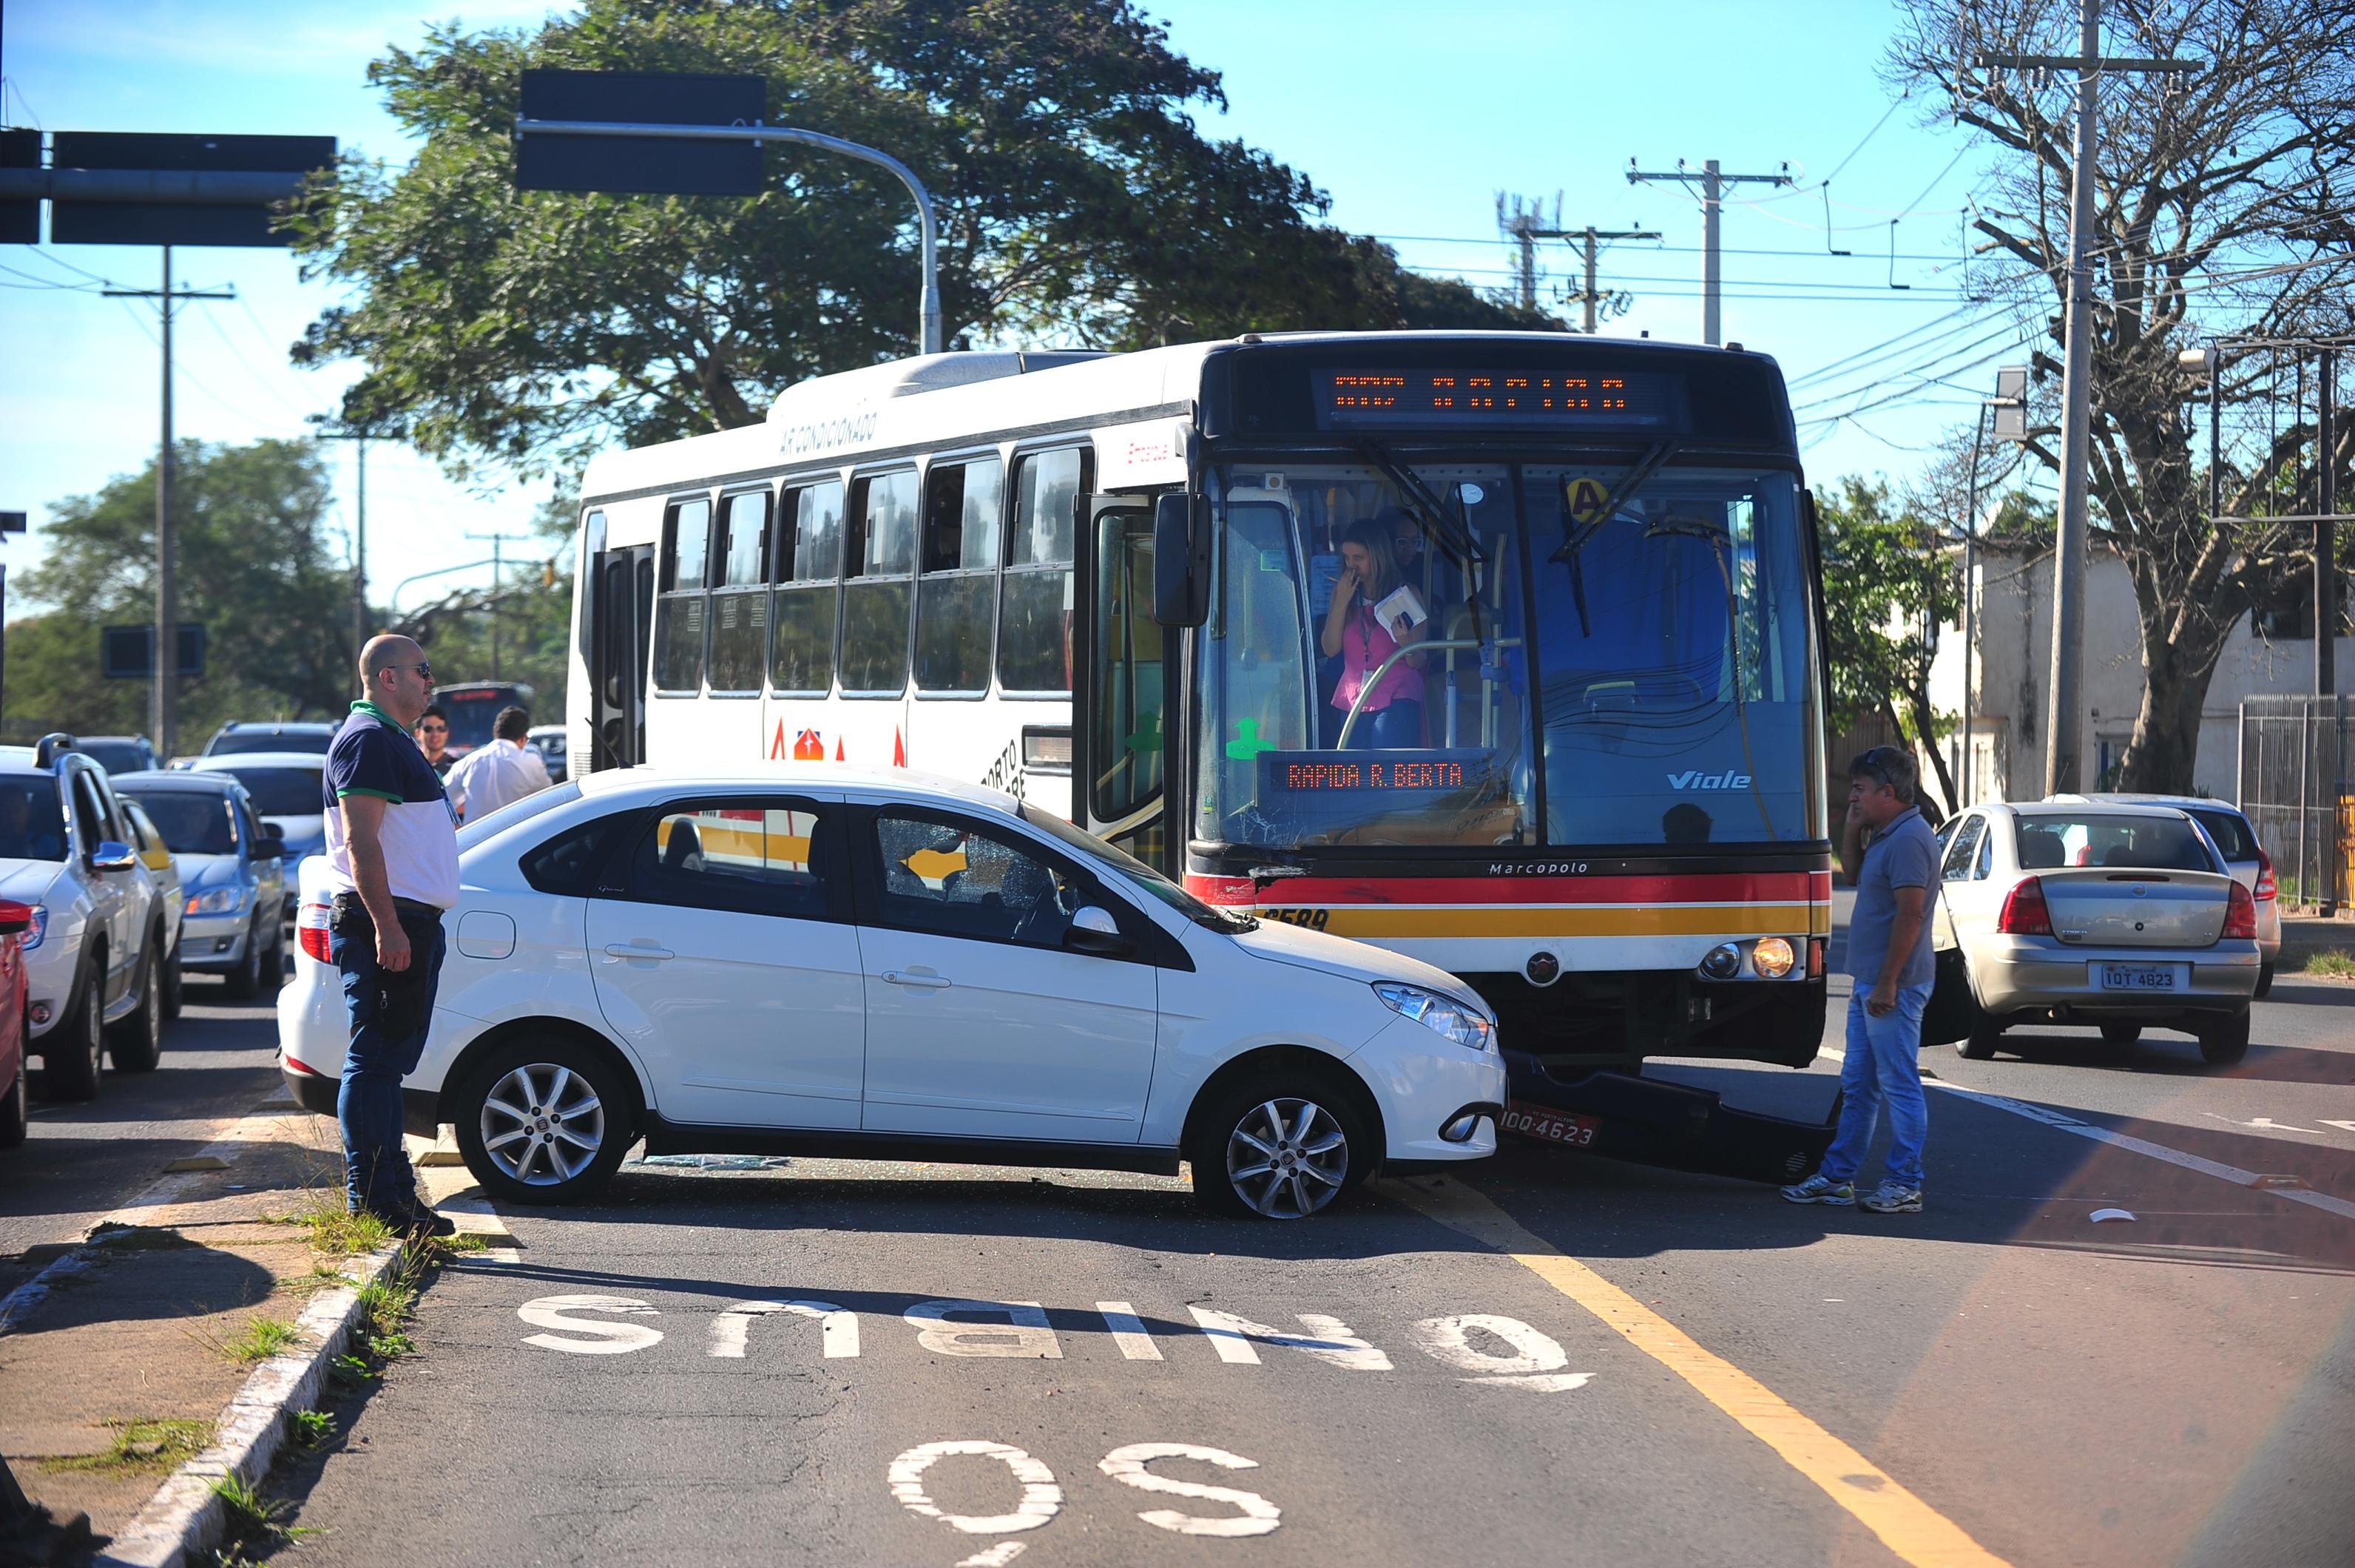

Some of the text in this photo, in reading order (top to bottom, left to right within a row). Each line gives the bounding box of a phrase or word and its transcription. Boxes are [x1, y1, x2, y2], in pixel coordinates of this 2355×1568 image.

[981, 739, 1017, 789] ORTO
[1289, 763, 1359, 788] RAPIDA
[1666, 770, 1752, 790] Viale
[1489, 862, 1588, 875] Marcopolo
